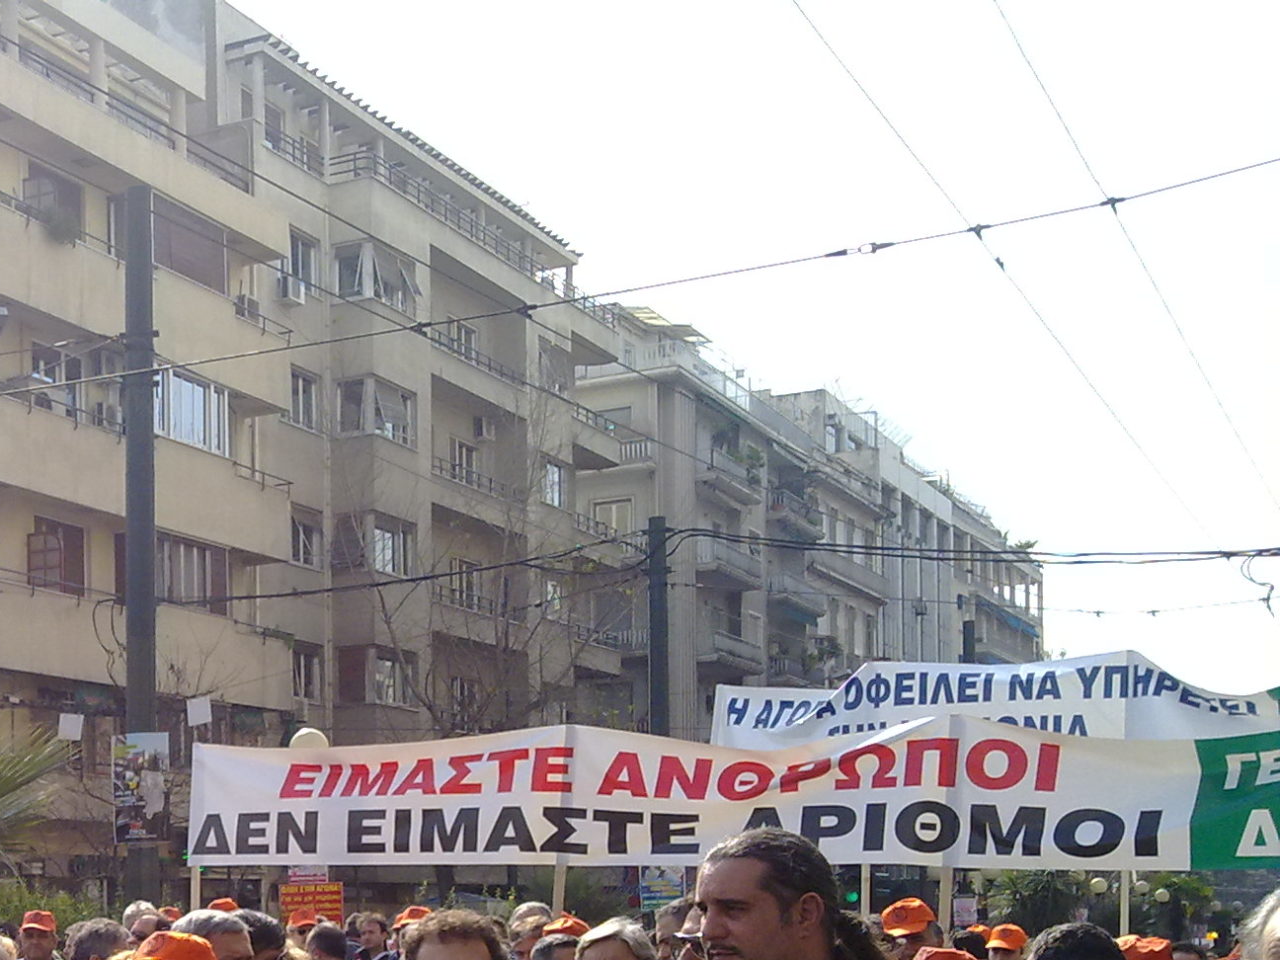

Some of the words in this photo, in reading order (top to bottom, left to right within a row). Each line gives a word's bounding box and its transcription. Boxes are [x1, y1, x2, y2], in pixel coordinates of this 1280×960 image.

[727, 697, 749, 726] Η
[843, 673, 995, 711] ΟΦΕΙΛΕΙ
[1008, 671, 1061, 701] ΝΑ
[278, 747, 574, 798] ΕΙΜΑΣΤΕ
[597, 738, 1060, 801] ΑΝΘΡΩΠΟΙ
[192, 810, 318, 856] ΔΕΝ
[347, 806, 700, 854] ΕΙΜΑΣΤΕ
